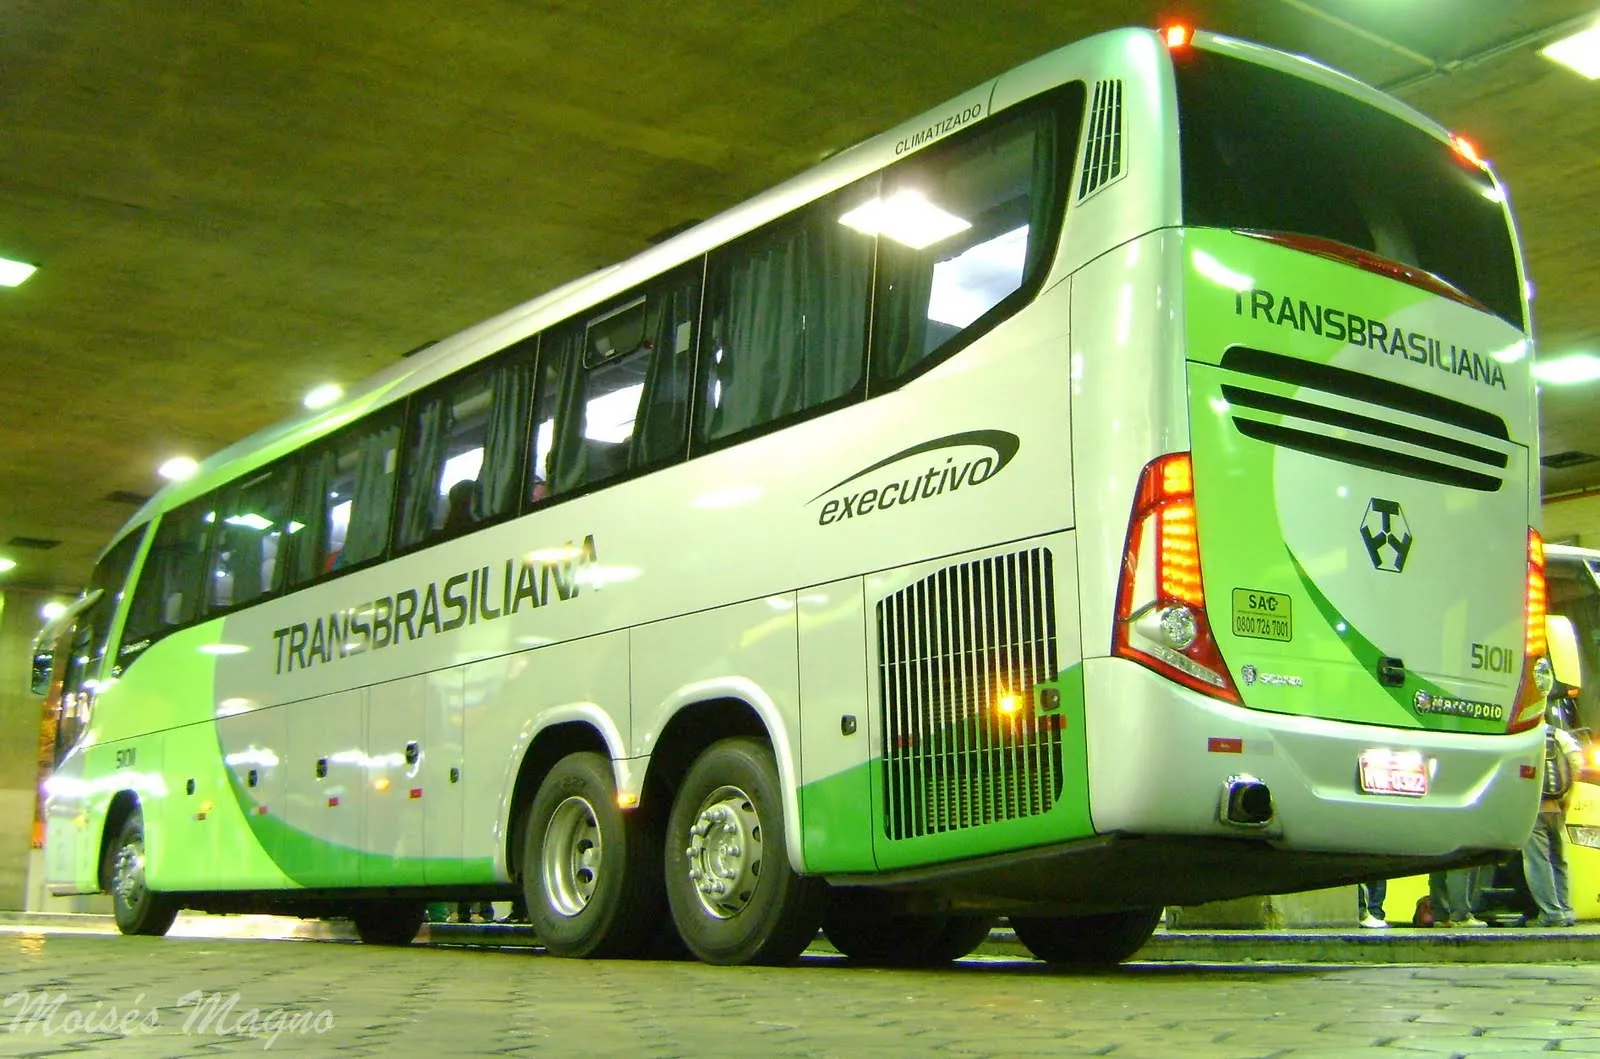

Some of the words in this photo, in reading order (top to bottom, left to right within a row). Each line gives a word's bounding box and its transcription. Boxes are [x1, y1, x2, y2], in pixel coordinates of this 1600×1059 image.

[895, 103, 981, 155] CLIMATIZADO
[1235, 288, 1507, 390] TRANSBRASILIANA
[818, 456, 993, 526] executivo
[1248, 594, 1278, 611] SAC
[1236, 616, 1255, 633] 0800
[1257, 618, 1271, 635] 726
[1272, 620, 1289, 638] 7001
[1471, 642, 1513, 674] 51011
